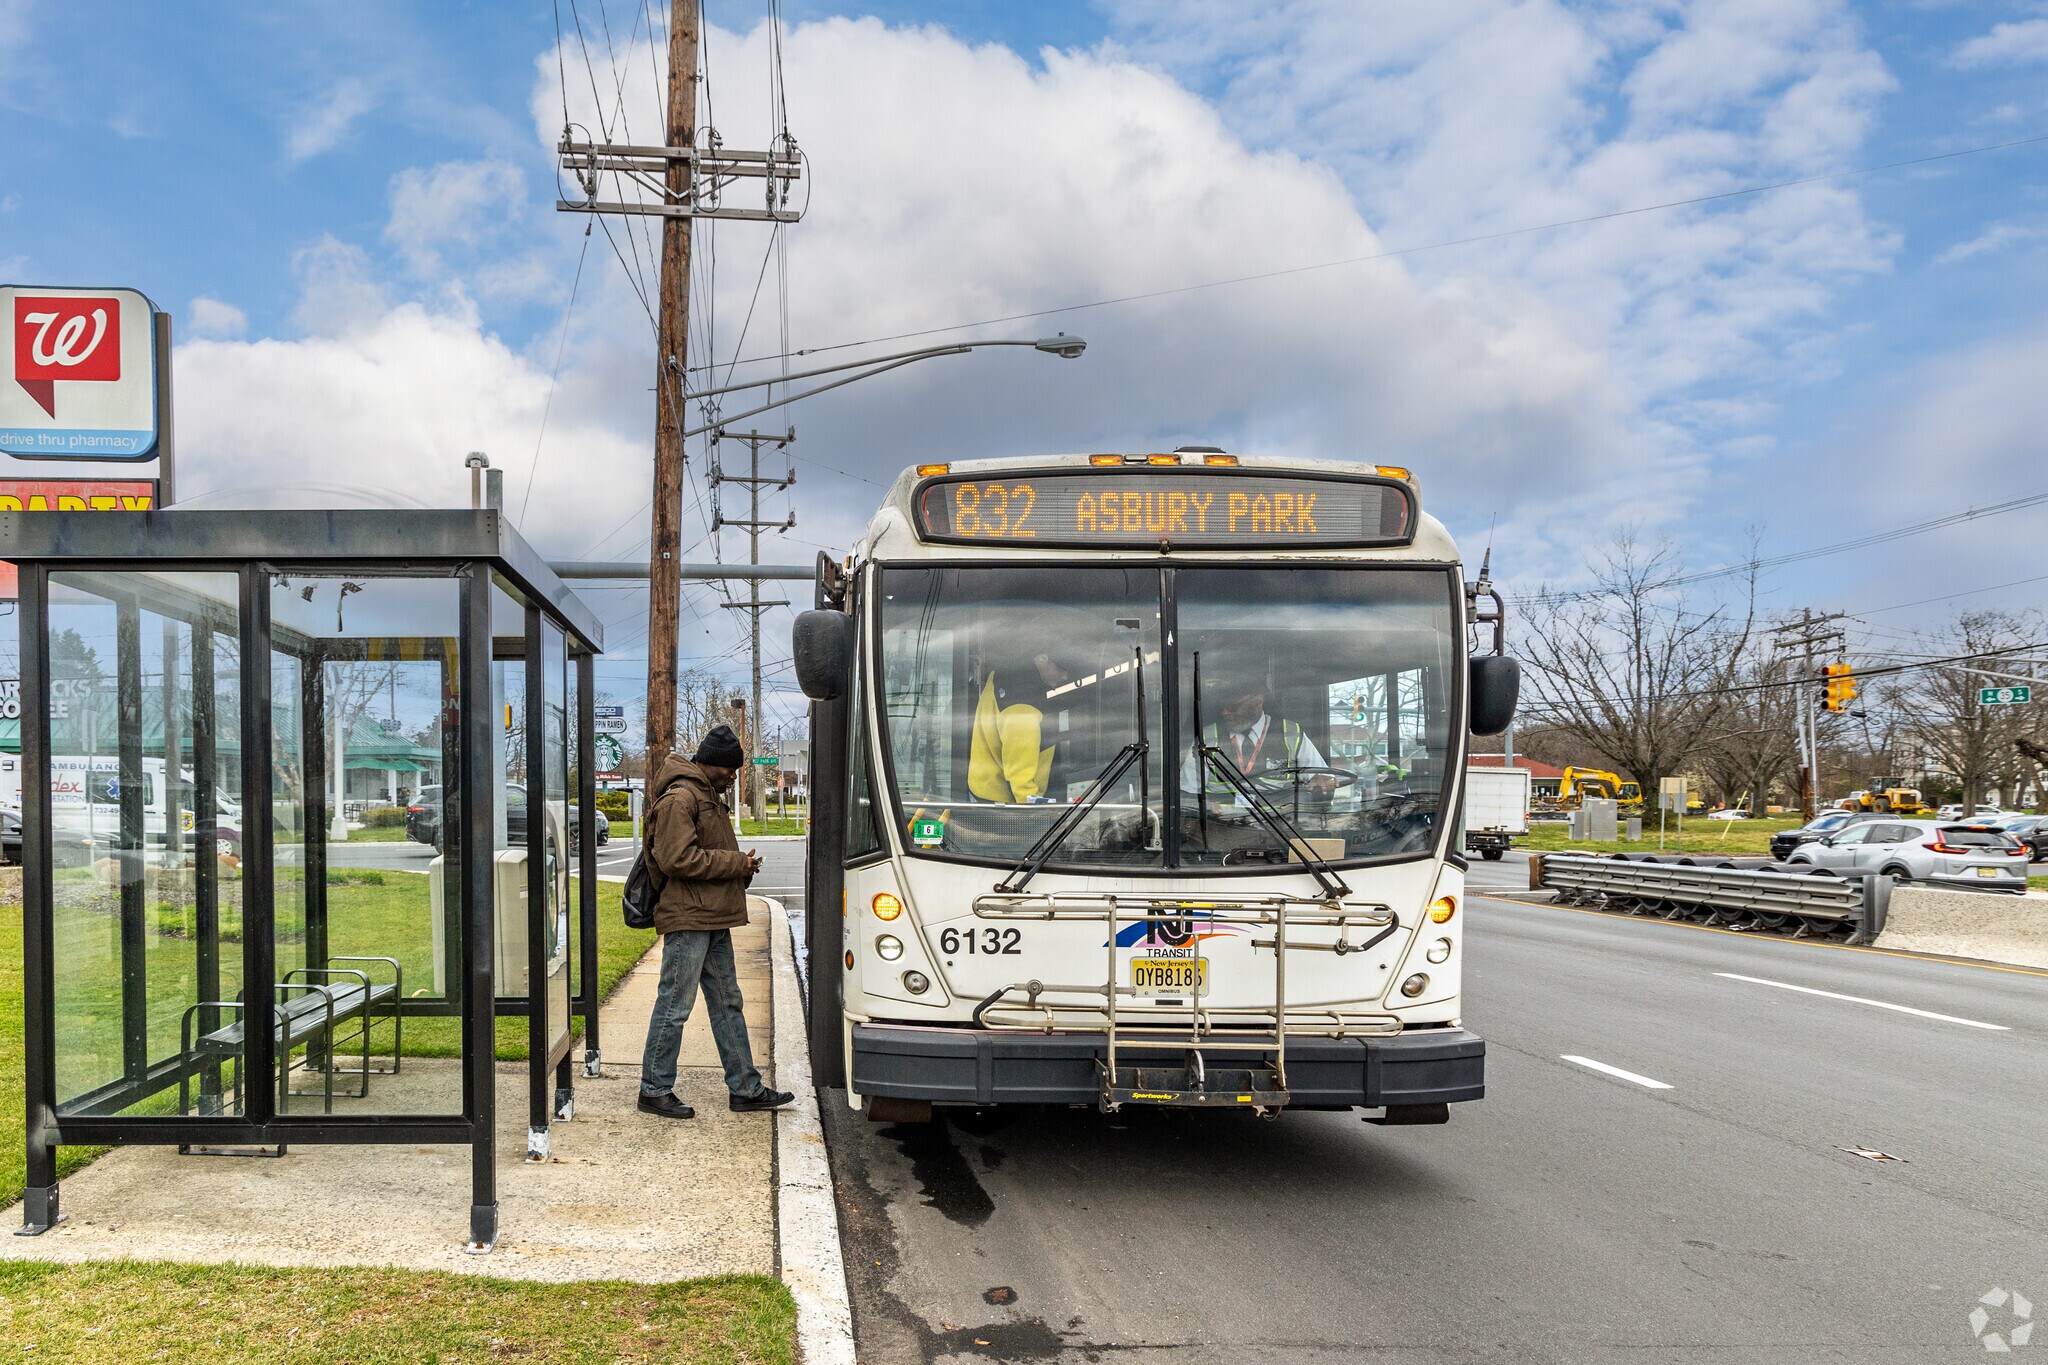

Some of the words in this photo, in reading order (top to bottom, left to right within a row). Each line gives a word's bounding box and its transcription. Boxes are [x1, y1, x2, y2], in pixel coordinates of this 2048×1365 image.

[0, 433, 34, 445] drive
[38, 433, 65, 446] thru
[70, 434, 138, 449] pharmacy
[955, 484, 1037, 538] 832
[1077, 491, 1213, 532] ASBURY
[1228, 492, 1318, 533] PARK
[2000, 691, 2010, 700] 35
[595, 720, 606, 728] PPIN
[607, 720, 624, 728] RAMEN
[51, 762, 119, 771] AMBULANC
[926, 825, 931, 834] 6
[940, 927, 1022, 955] 6132
[1146, 948, 1193, 958] TRANSIT
[1167, 960, 1189, 968] Jersey
[1132, 1092, 1172, 1100] Sportworks
